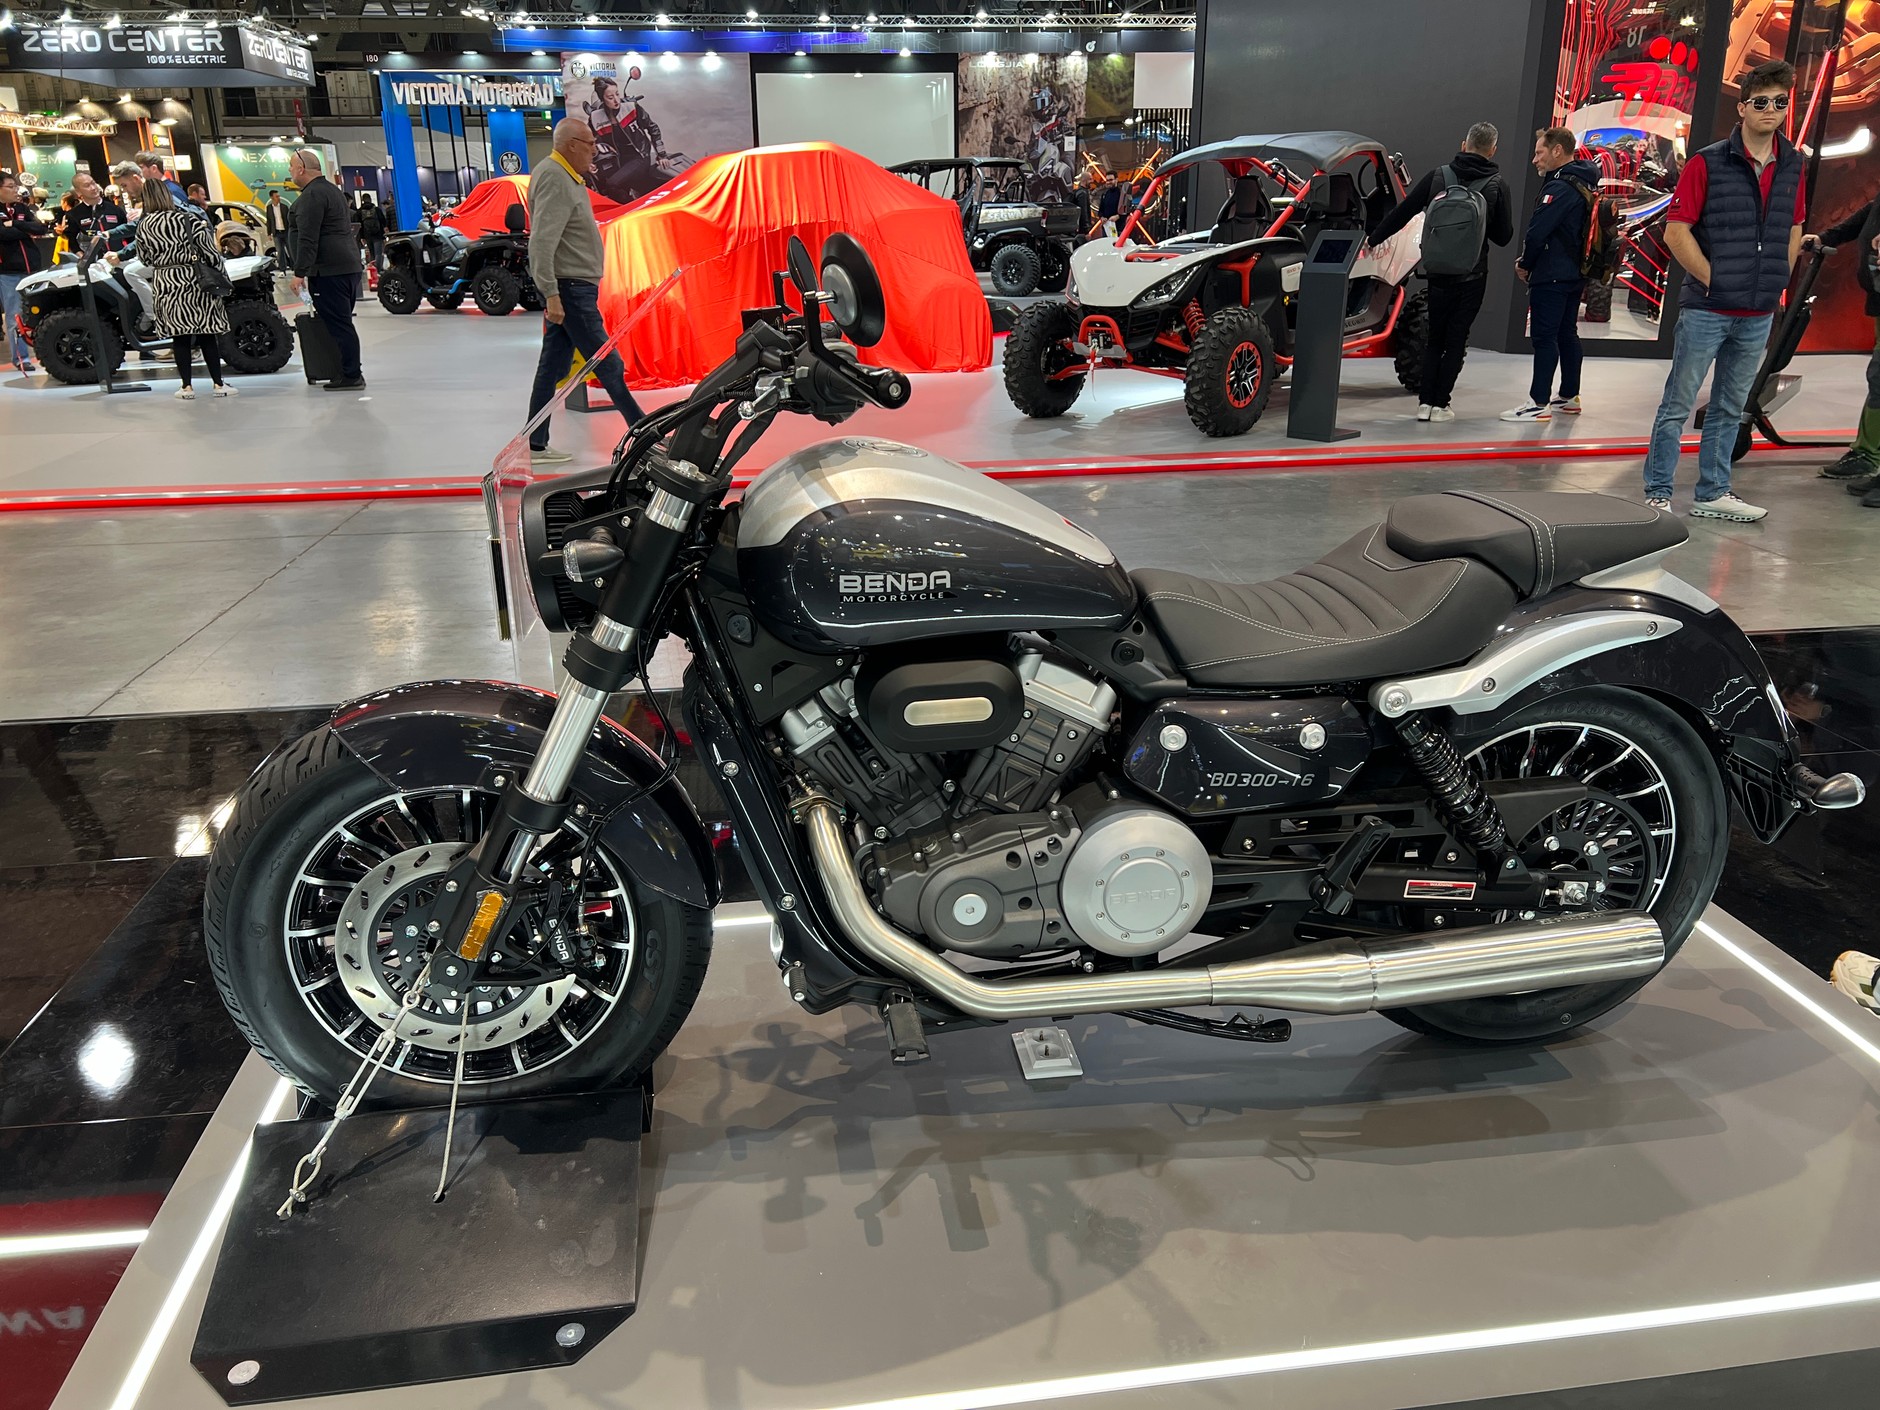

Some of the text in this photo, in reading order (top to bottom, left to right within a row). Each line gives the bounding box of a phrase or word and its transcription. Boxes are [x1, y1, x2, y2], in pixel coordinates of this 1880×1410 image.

[21, 29, 225, 52] ZERO CENTER
[246, 33, 307, 70] ZERO CENTER
[365, 54, 379, 63] 180
[391, 82, 554, 106] VICTORIA MOTORRAD
[839, 570, 951, 593] BENDA
[842, 591, 945, 603] MOTORCYCLE
